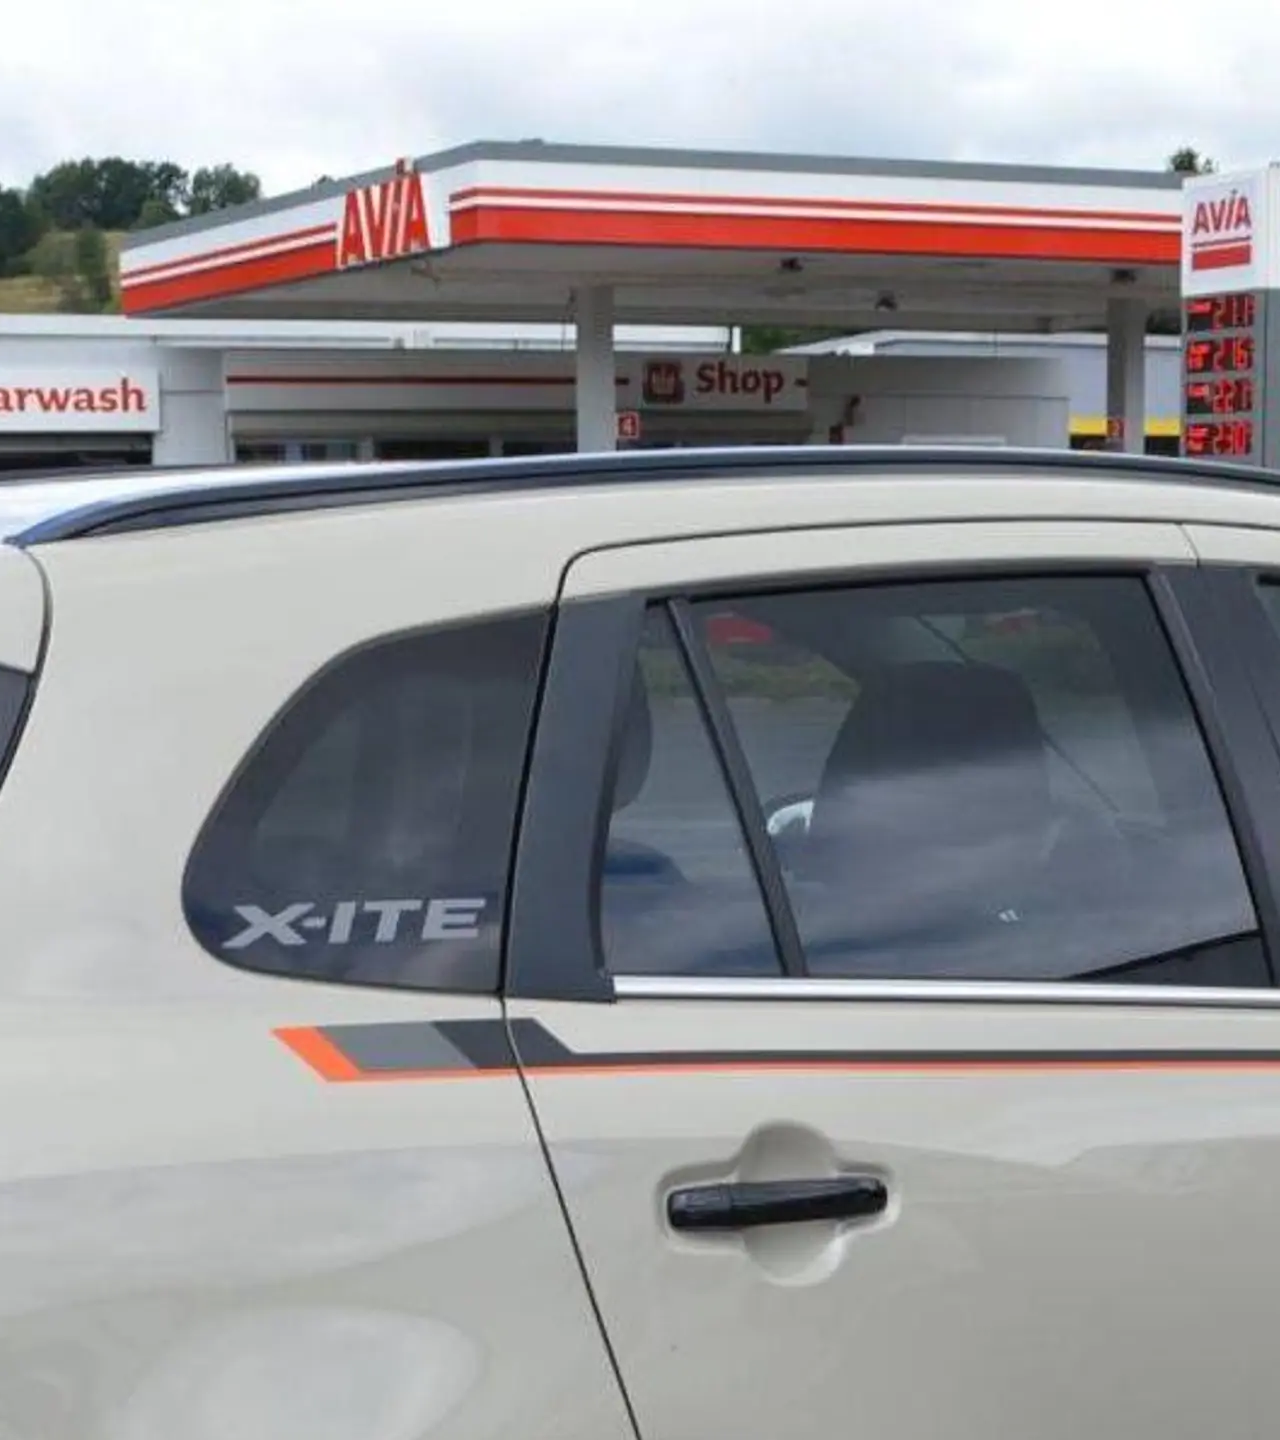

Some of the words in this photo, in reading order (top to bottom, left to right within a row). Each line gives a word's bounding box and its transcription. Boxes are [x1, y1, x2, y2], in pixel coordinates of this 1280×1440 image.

[338, 158, 431, 267] AVIA
[1193, 189, 1252, 235] AVIA
[696, 361, 785, 402] Shop
[221, 897, 486, 950] X-ITE
